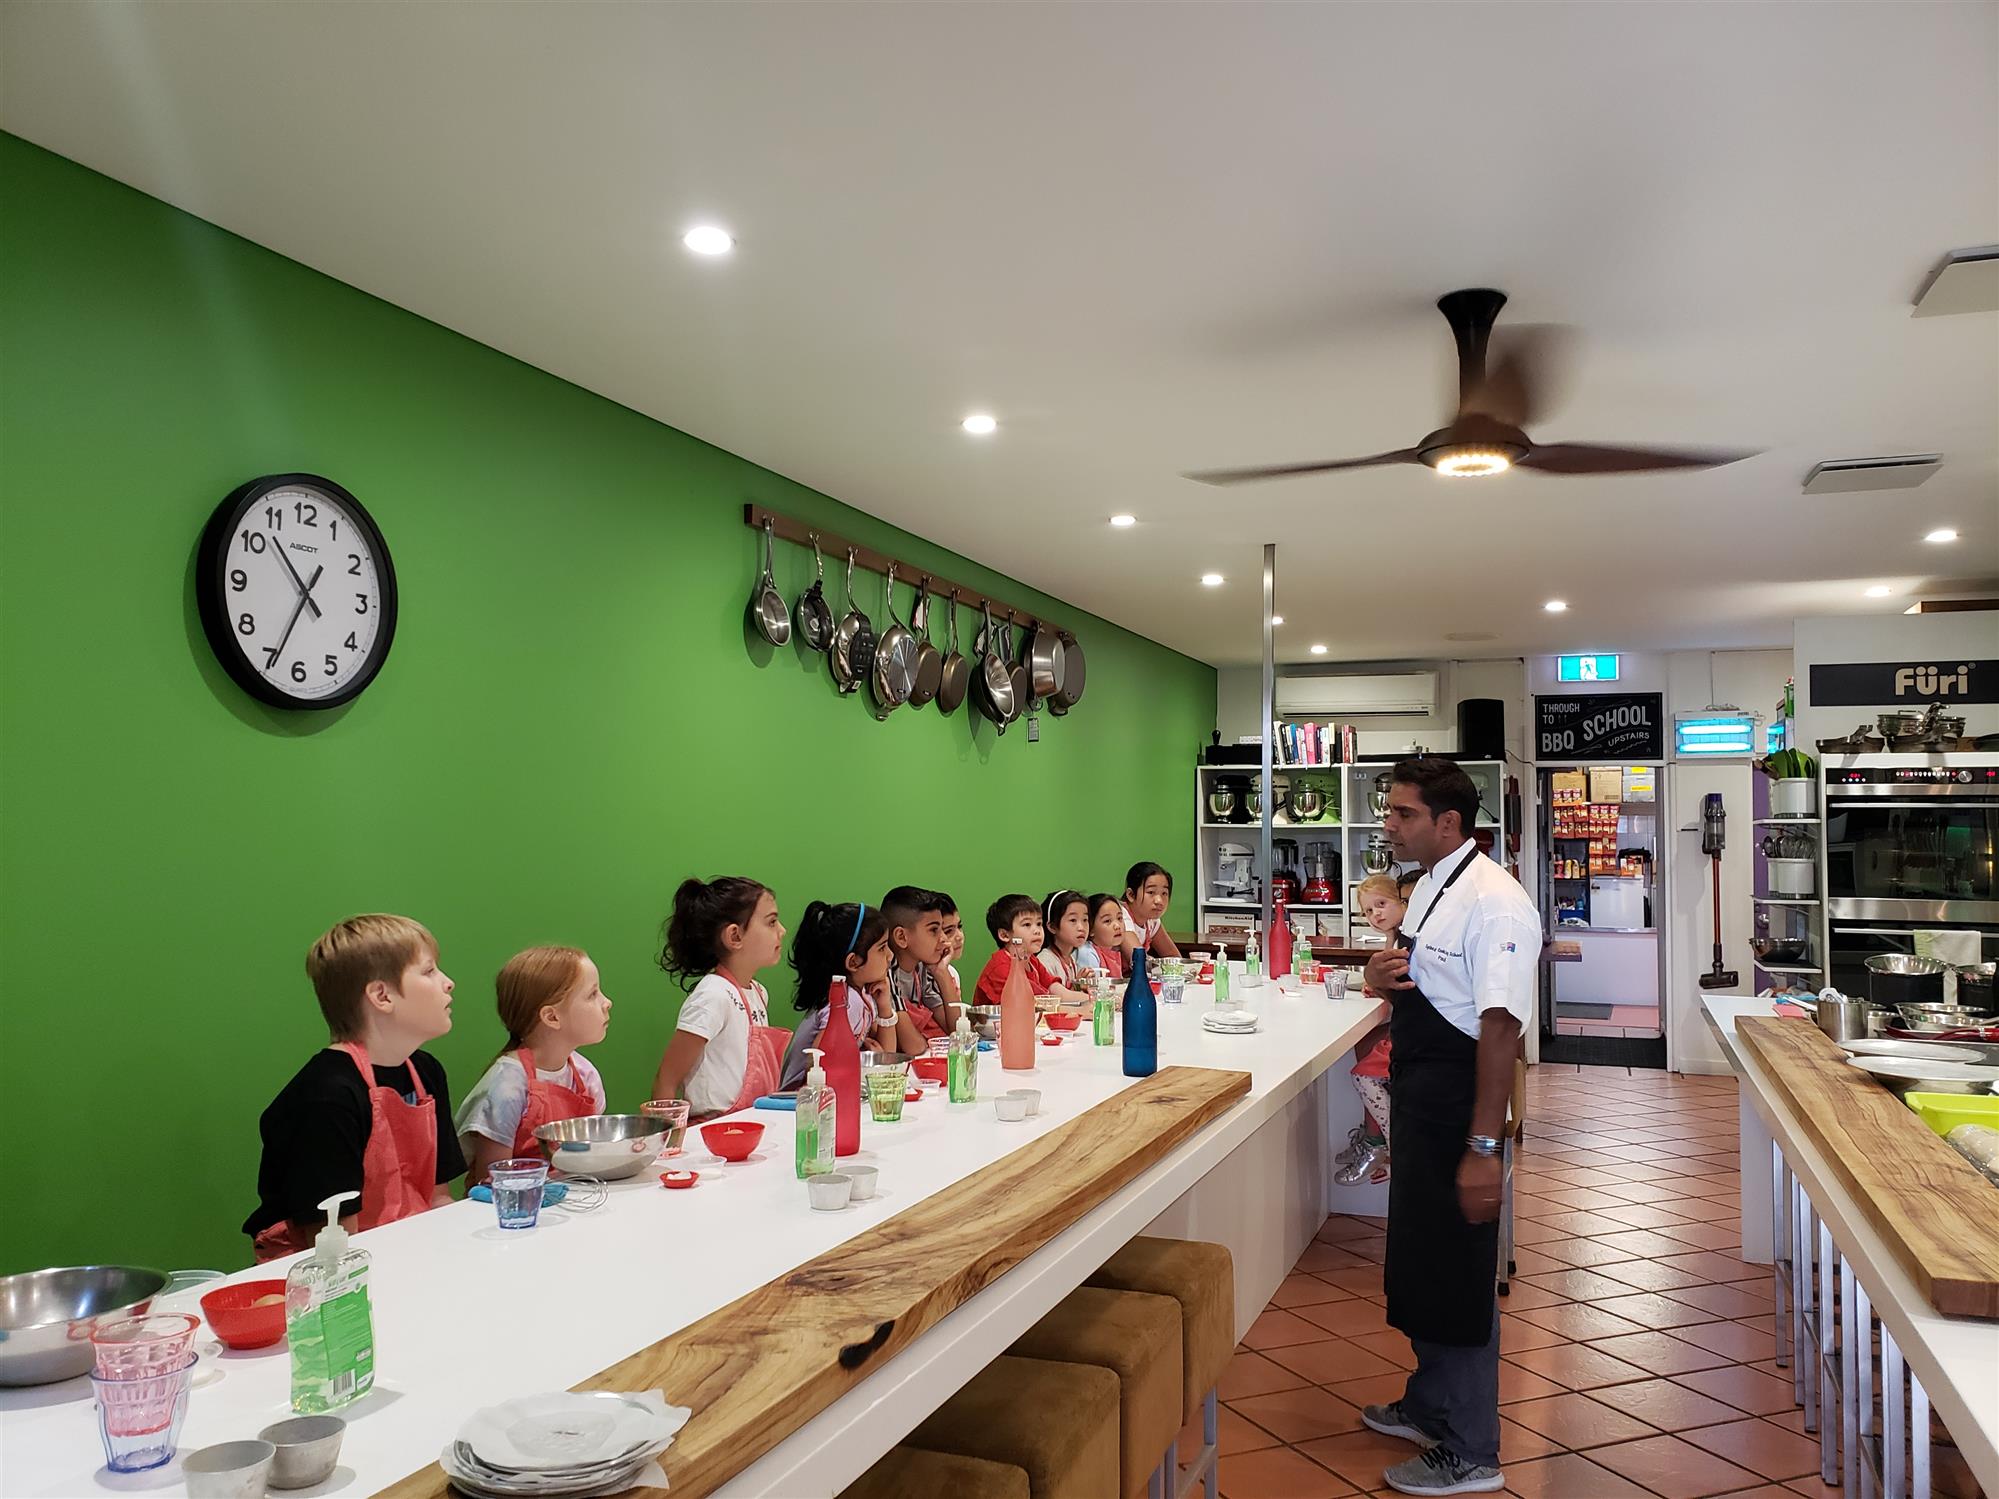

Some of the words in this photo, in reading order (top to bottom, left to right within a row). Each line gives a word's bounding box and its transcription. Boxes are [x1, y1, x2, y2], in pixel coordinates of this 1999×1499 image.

[265, 506, 283, 531] 11
[294, 502, 318, 527] 12
[241, 529, 266, 554] 10
[329, 520, 337, 541] 1
[290, 542, 318, 554] ASCOT
[347, 554, 362, 576] 2
[230, 569, 248, 592] 9
[355, 593, 368, 614] 3
[238, 613, 255, 635] 8
[344, 631, 358, 652] 4
[262, 647, 277, 670] 7
[324, 654, 338, 676] 5
[291, 661, 307, 682] 6
[1895, 665, 1969, 696] Füri
[1542, 703, 1580, 713] THROUGH
[1542, 714, 1554, 725] TO
[1542, 730, 1575, 752] BBQ
[1582, 705, 1652, 741] SCHOOL
[1608, 731, 1650, 747] UPSTAIRS
